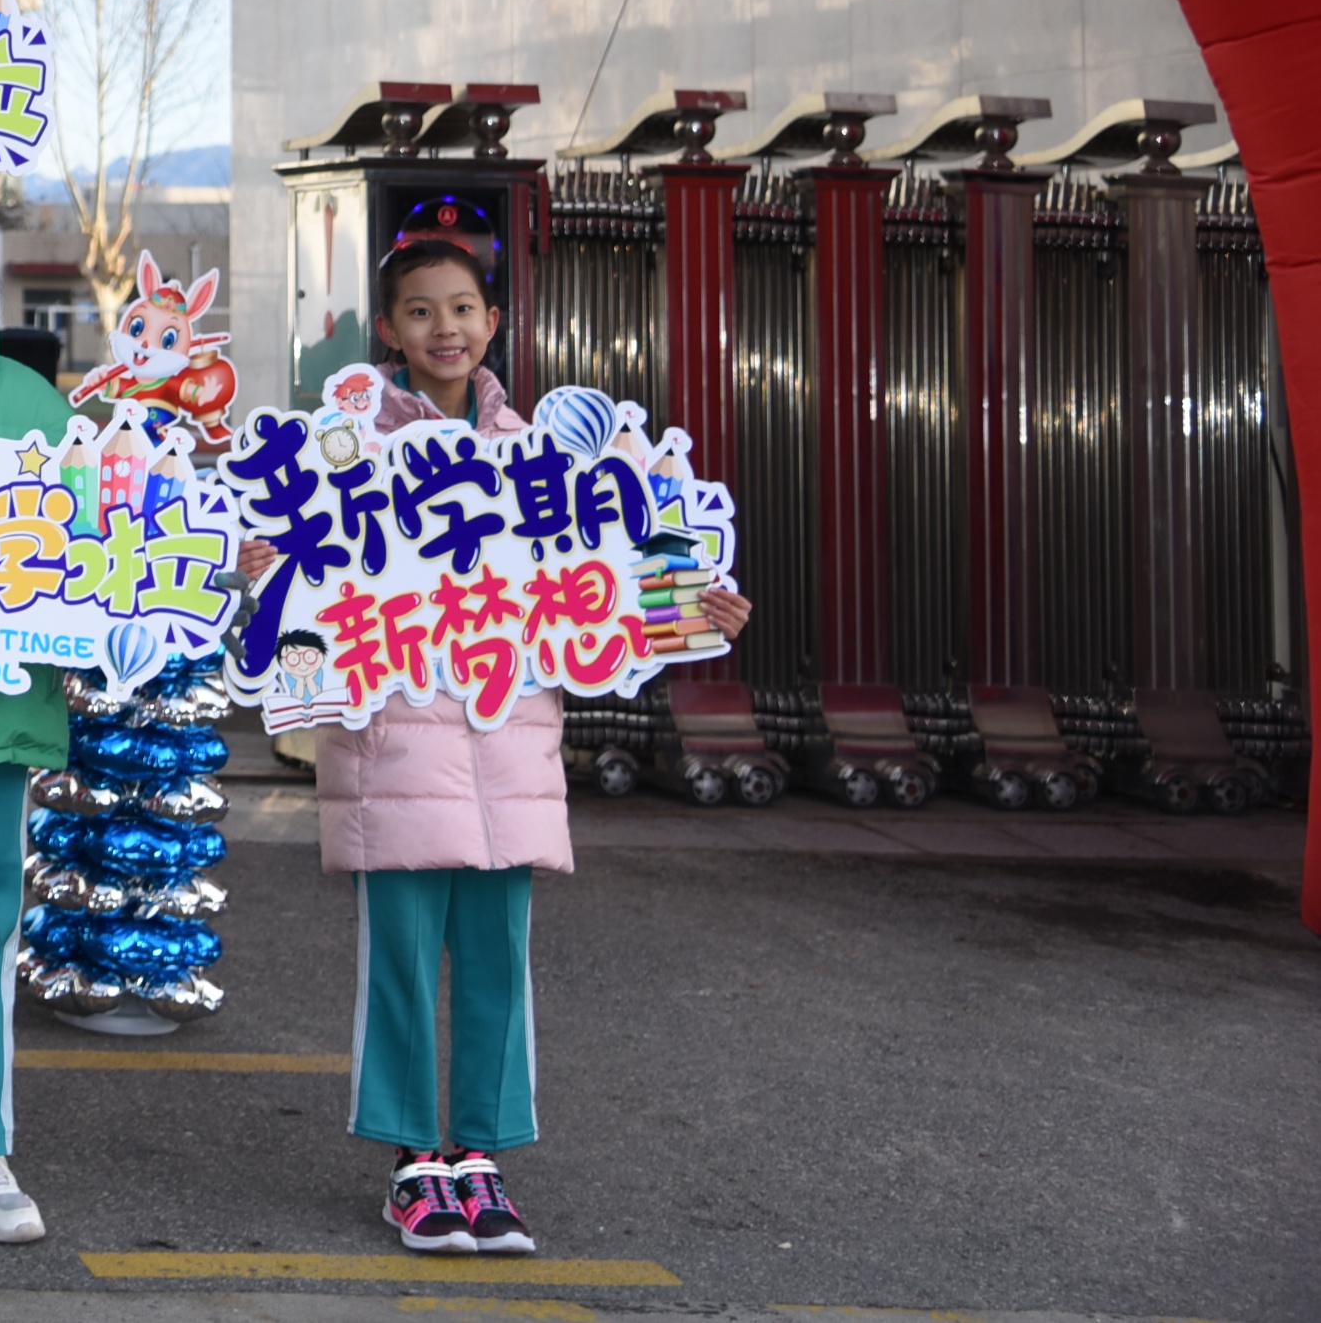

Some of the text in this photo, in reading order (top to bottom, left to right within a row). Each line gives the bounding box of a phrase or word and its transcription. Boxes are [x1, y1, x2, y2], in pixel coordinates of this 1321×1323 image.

[227, 414, 652, 677] 新学期
[317, 561, 653, 719] 新梦想
